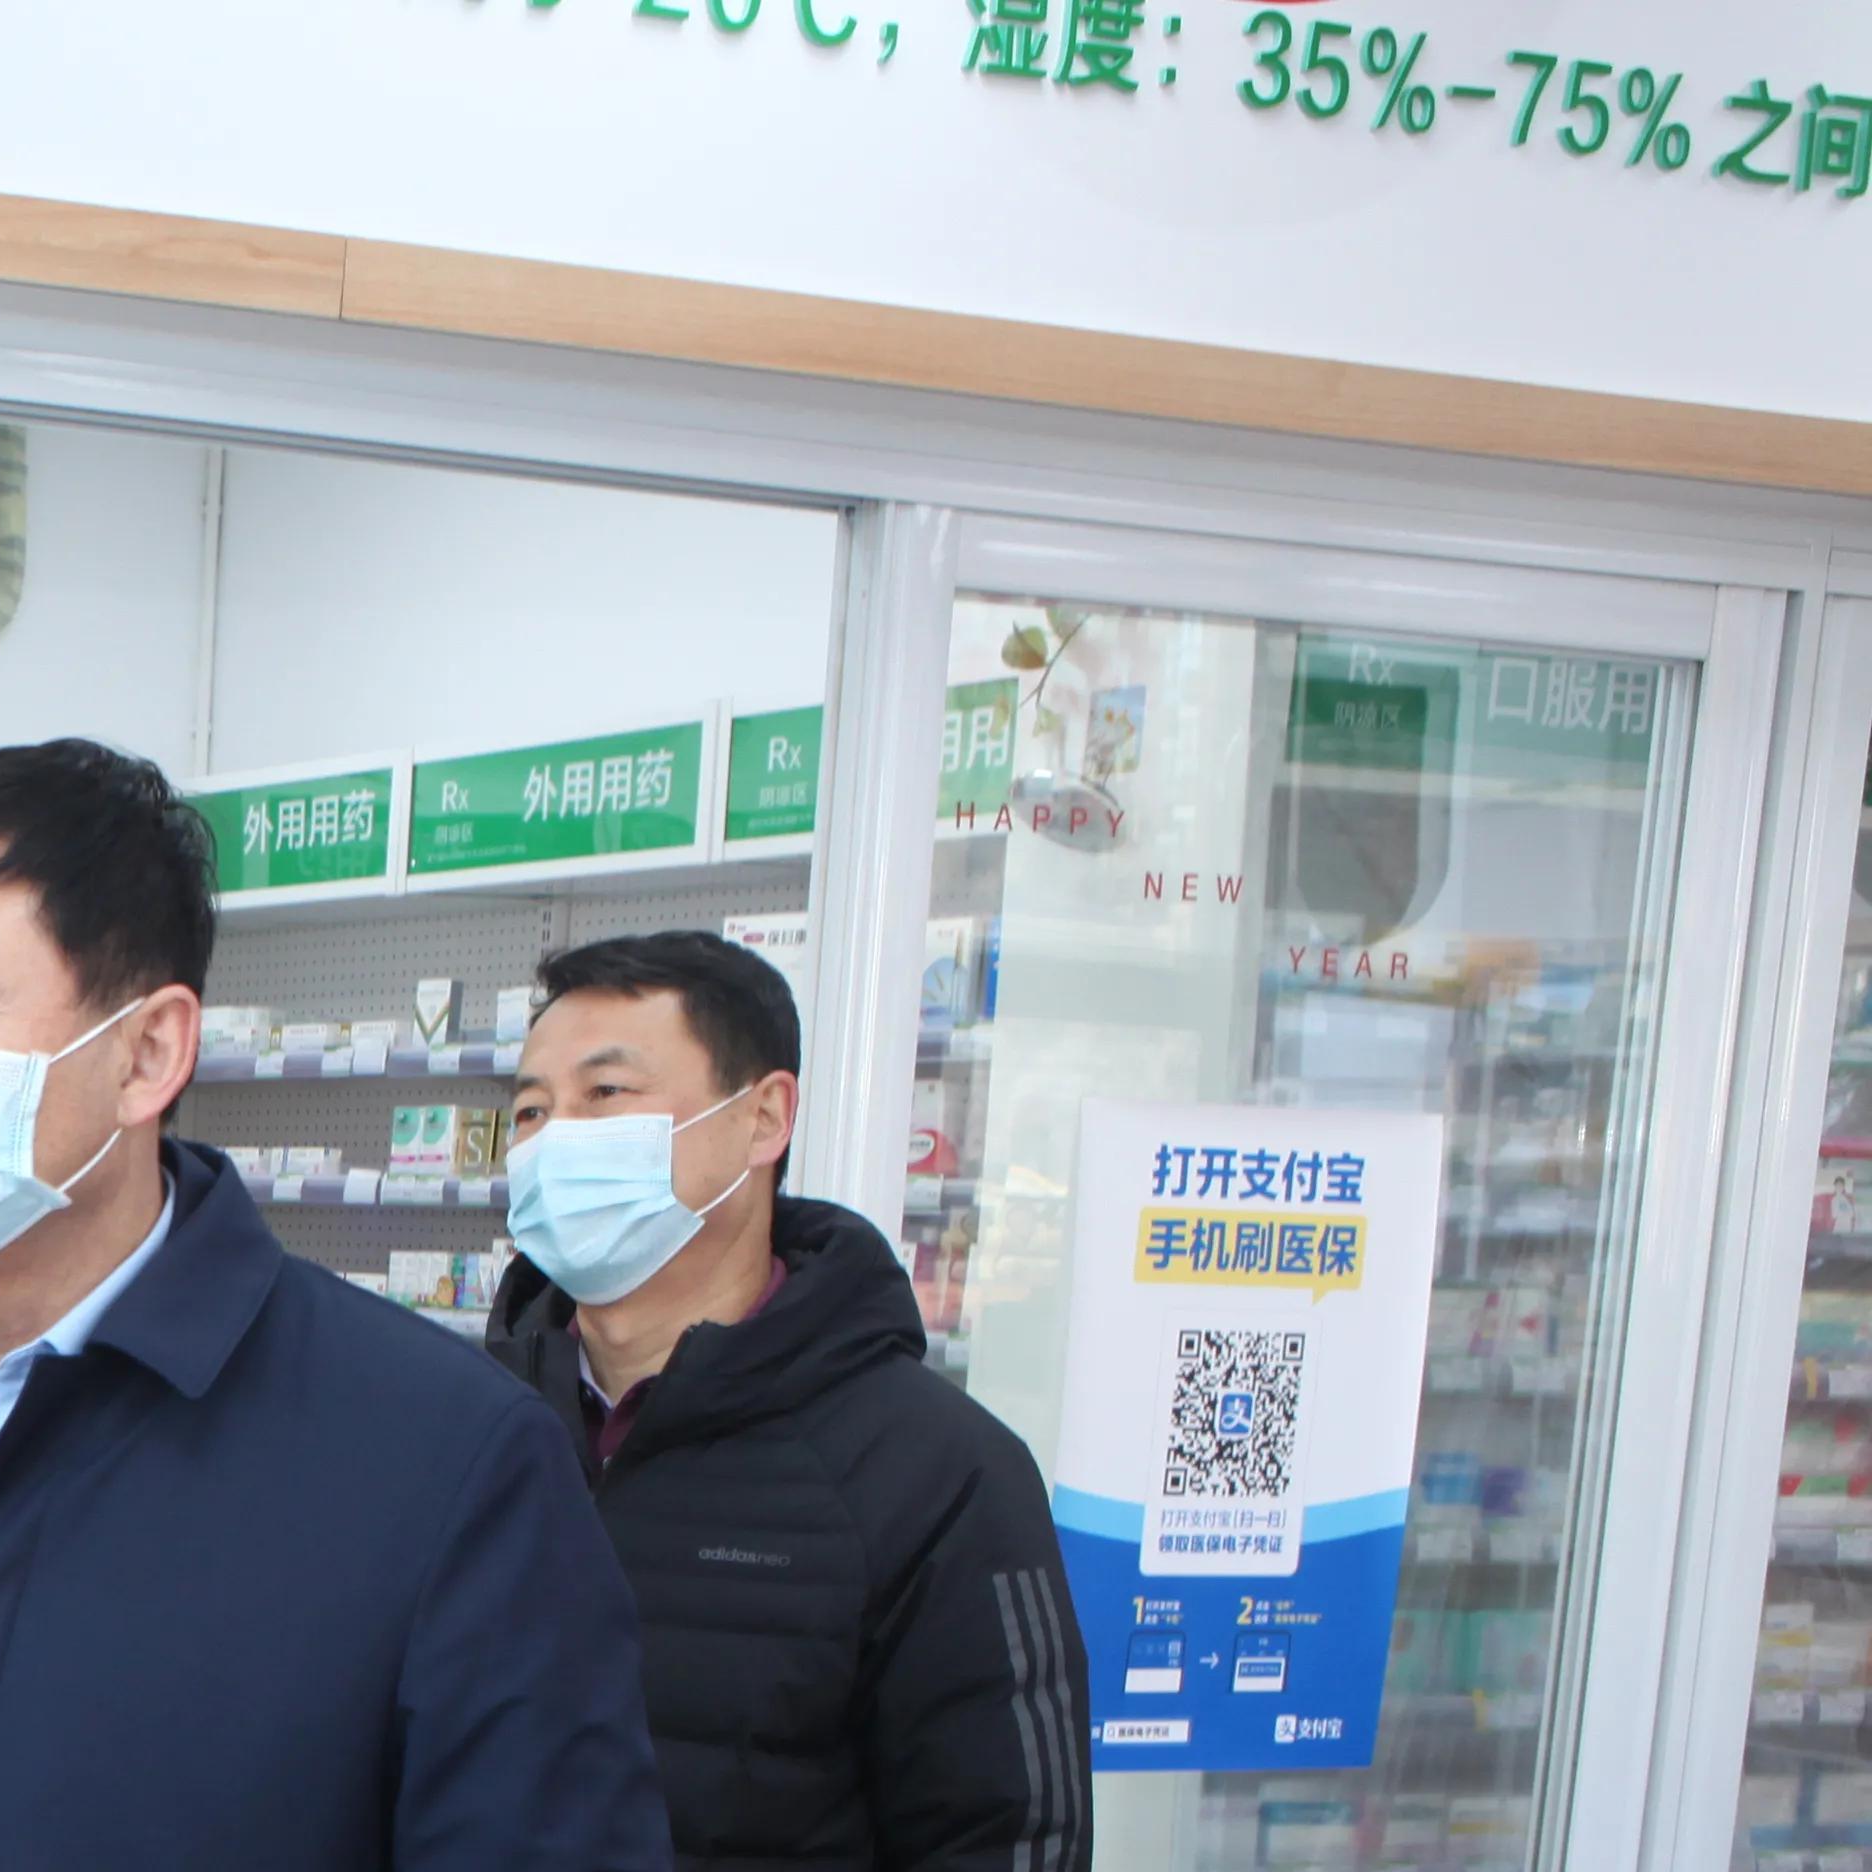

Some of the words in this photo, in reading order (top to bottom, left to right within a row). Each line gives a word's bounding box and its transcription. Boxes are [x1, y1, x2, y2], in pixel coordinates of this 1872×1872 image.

[767, 735, 802, 772] Rx
[440, 781, 470, 813] Rx
[522, 746, 676, 823] 外用用药
[242, 788, 377, 856] 外用用药
[956, 801, 1127, 838] HAPPY
[1144, 872, 1244, 904] NEW
[1287, 946, 1410, 980] YEAR
[1152, 1143, 1365, 1204] 打开支付宝
[1145, 1217, 1358, 1277] 手机刷医保
[1158, 1533, 1284, 1555] 领取医保电子凭证
[1297, 1717, 1343, 1741] 支付宝
